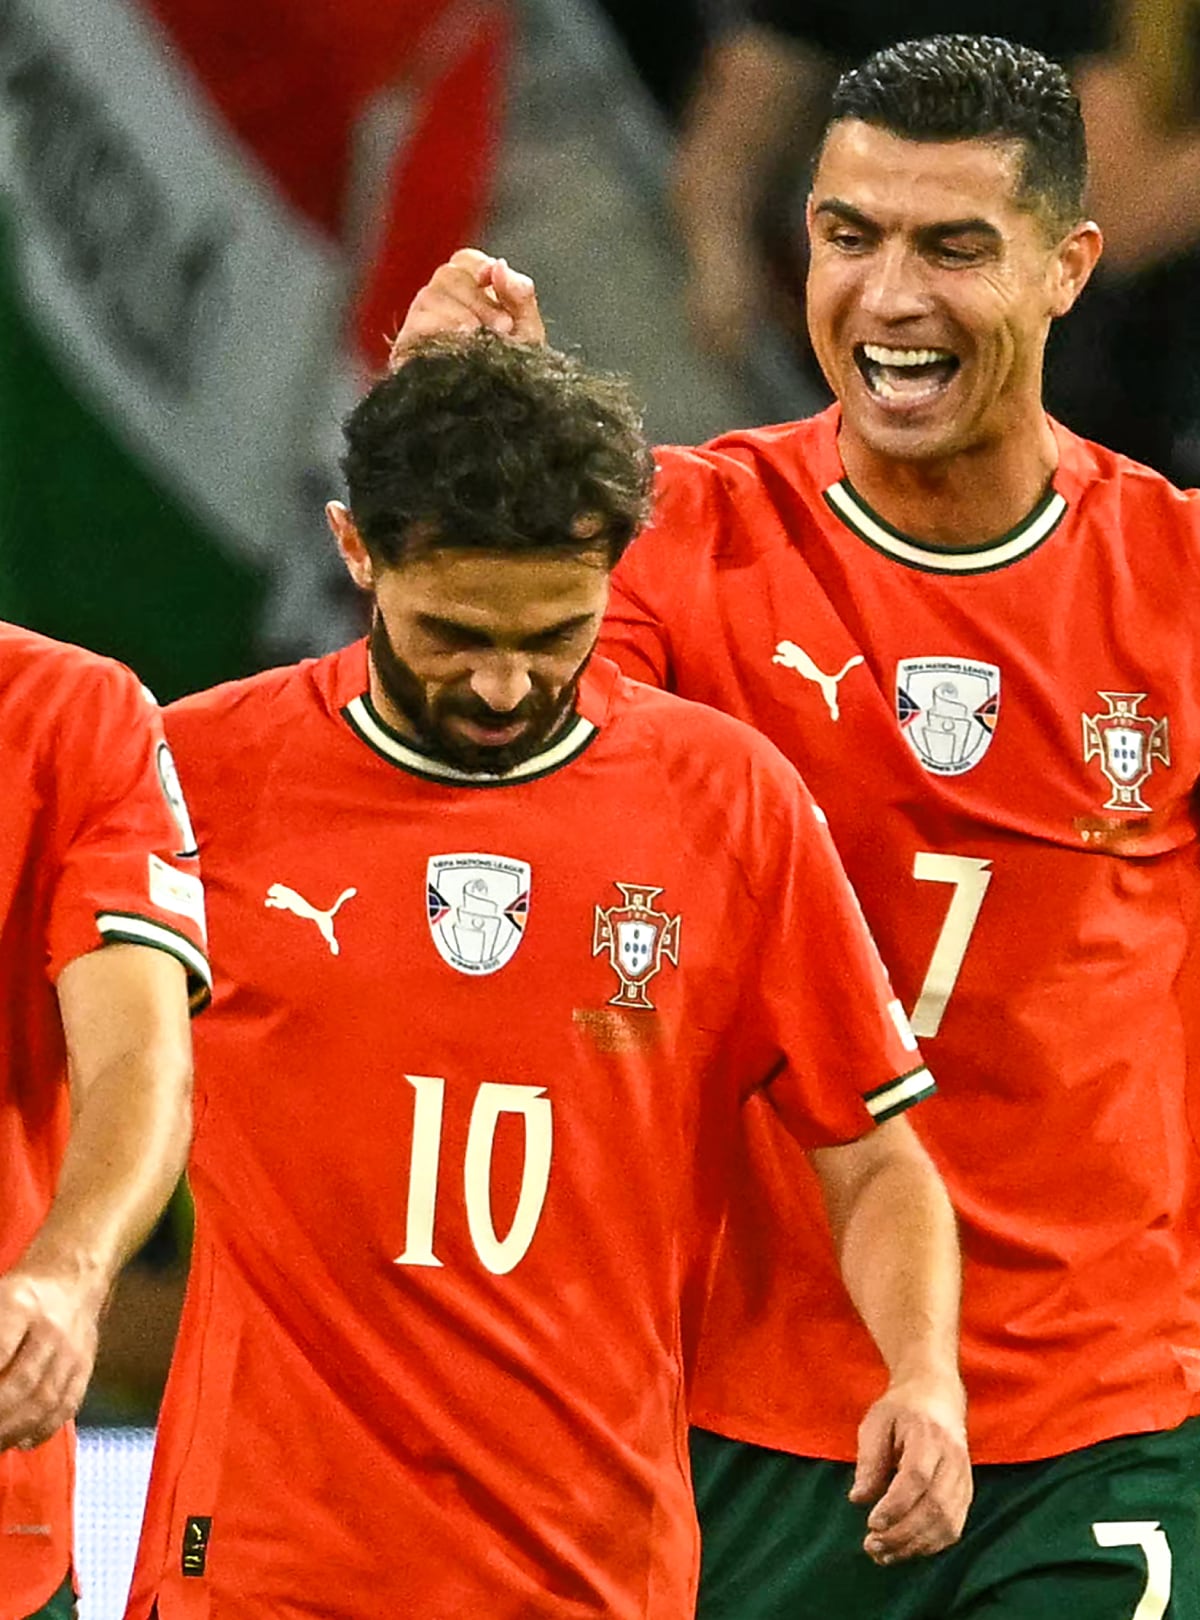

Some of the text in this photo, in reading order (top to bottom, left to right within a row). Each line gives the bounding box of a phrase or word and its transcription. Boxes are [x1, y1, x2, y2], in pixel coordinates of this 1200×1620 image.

[912, 851, 994, 1039] 7
[392, 1073, 553, 1275] 10
[1091, 1520, 1173, 1620] 7
